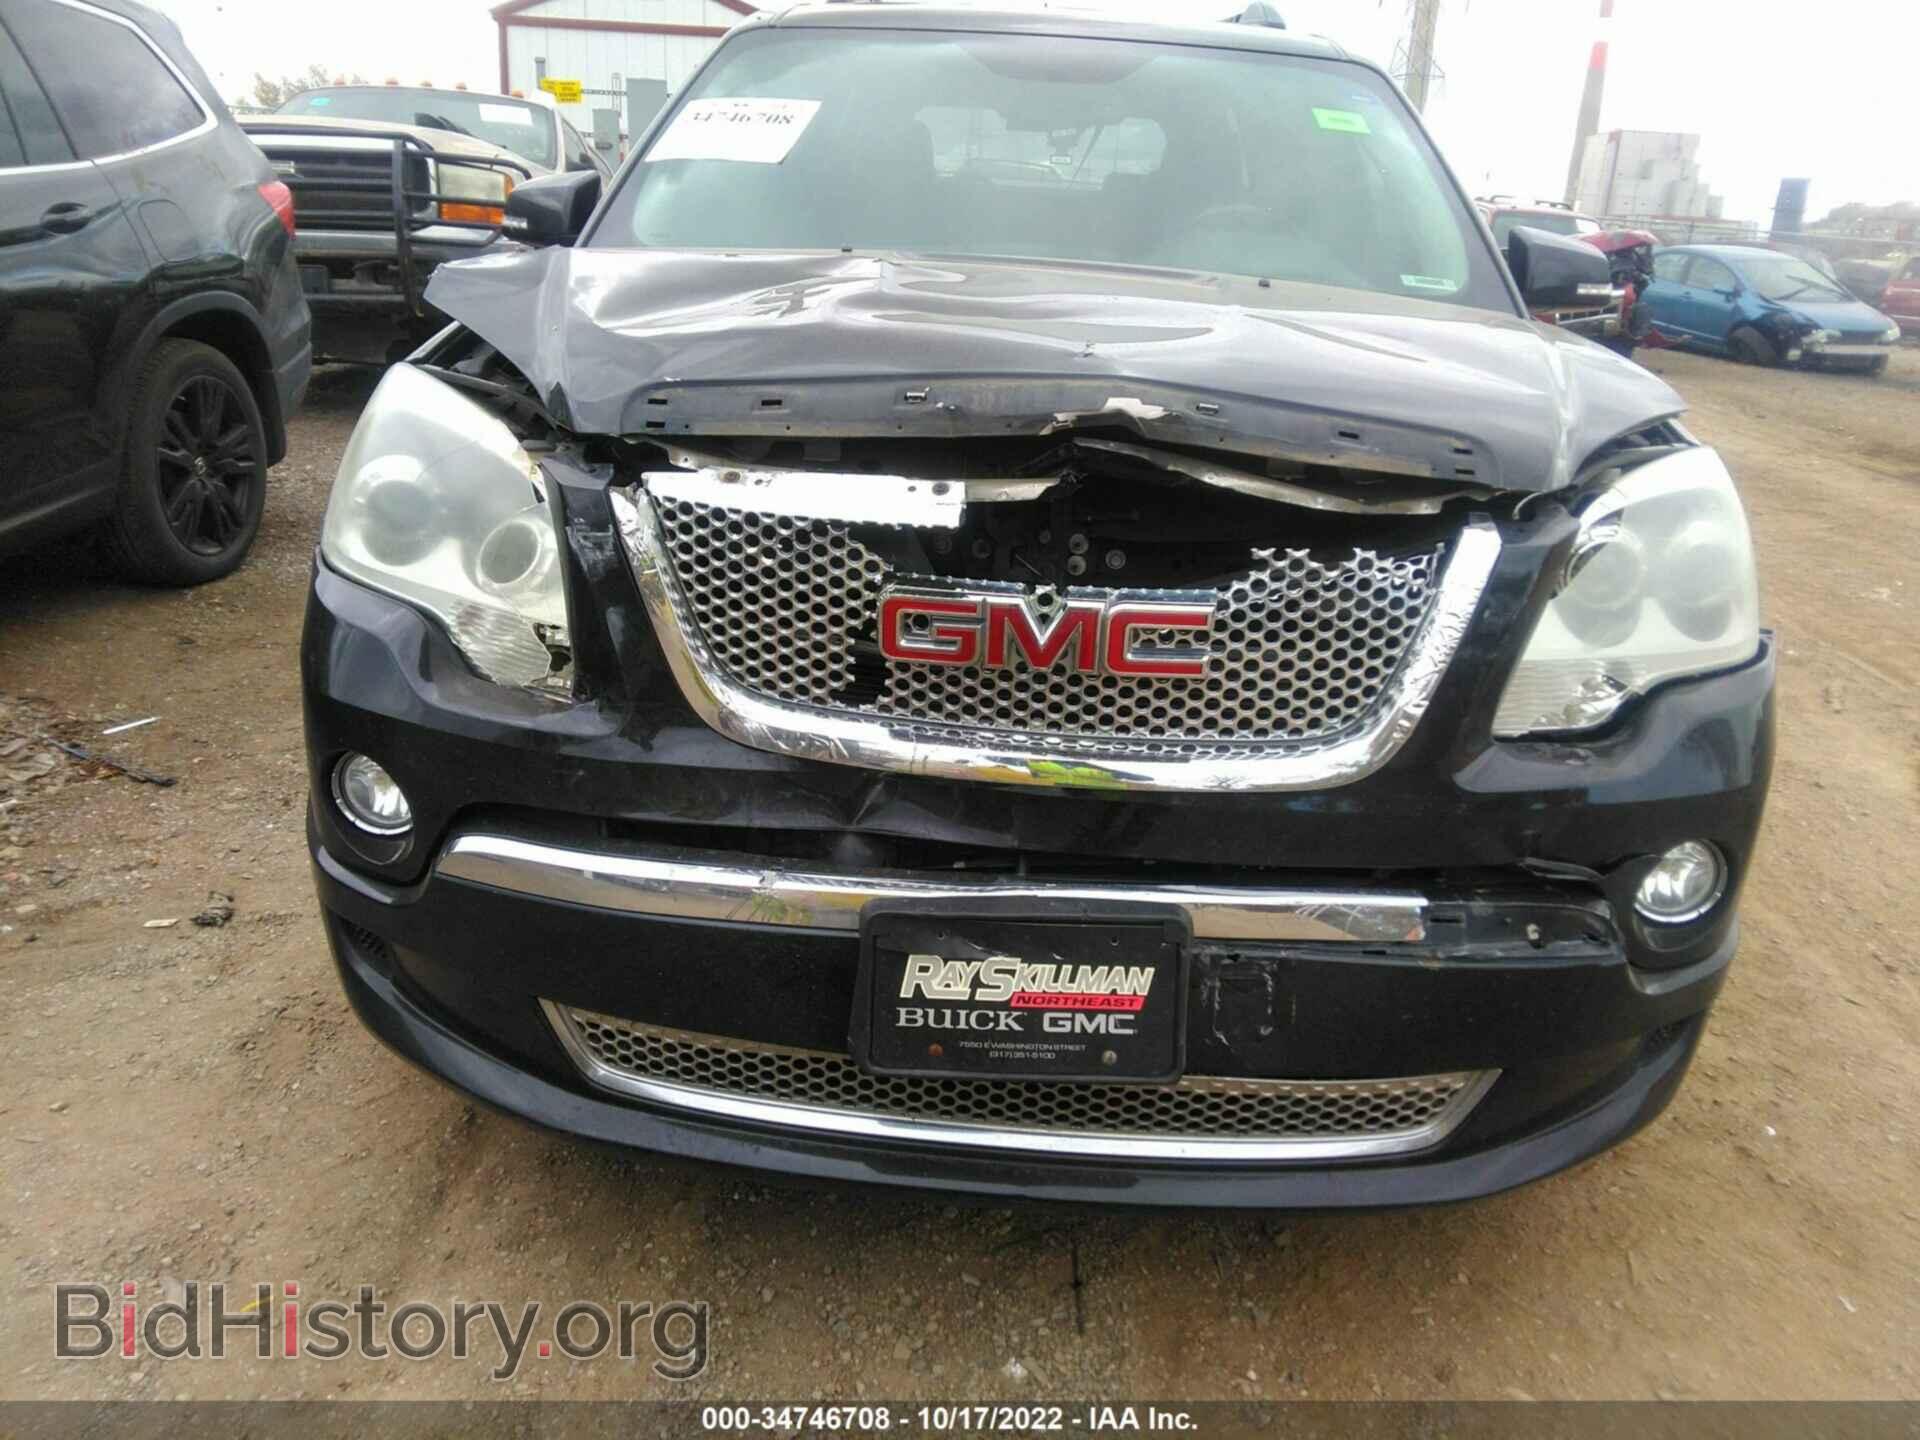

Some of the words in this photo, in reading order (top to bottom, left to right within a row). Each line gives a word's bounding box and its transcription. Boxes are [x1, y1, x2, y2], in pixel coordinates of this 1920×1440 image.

[879, 592, 1215, 677] GMC
[1014, 995, 1139, 1009] NORTHEAST
[896, 1007, 1024, 1032] BUICK
[1042, 1012, 1136, 1035] GMC
